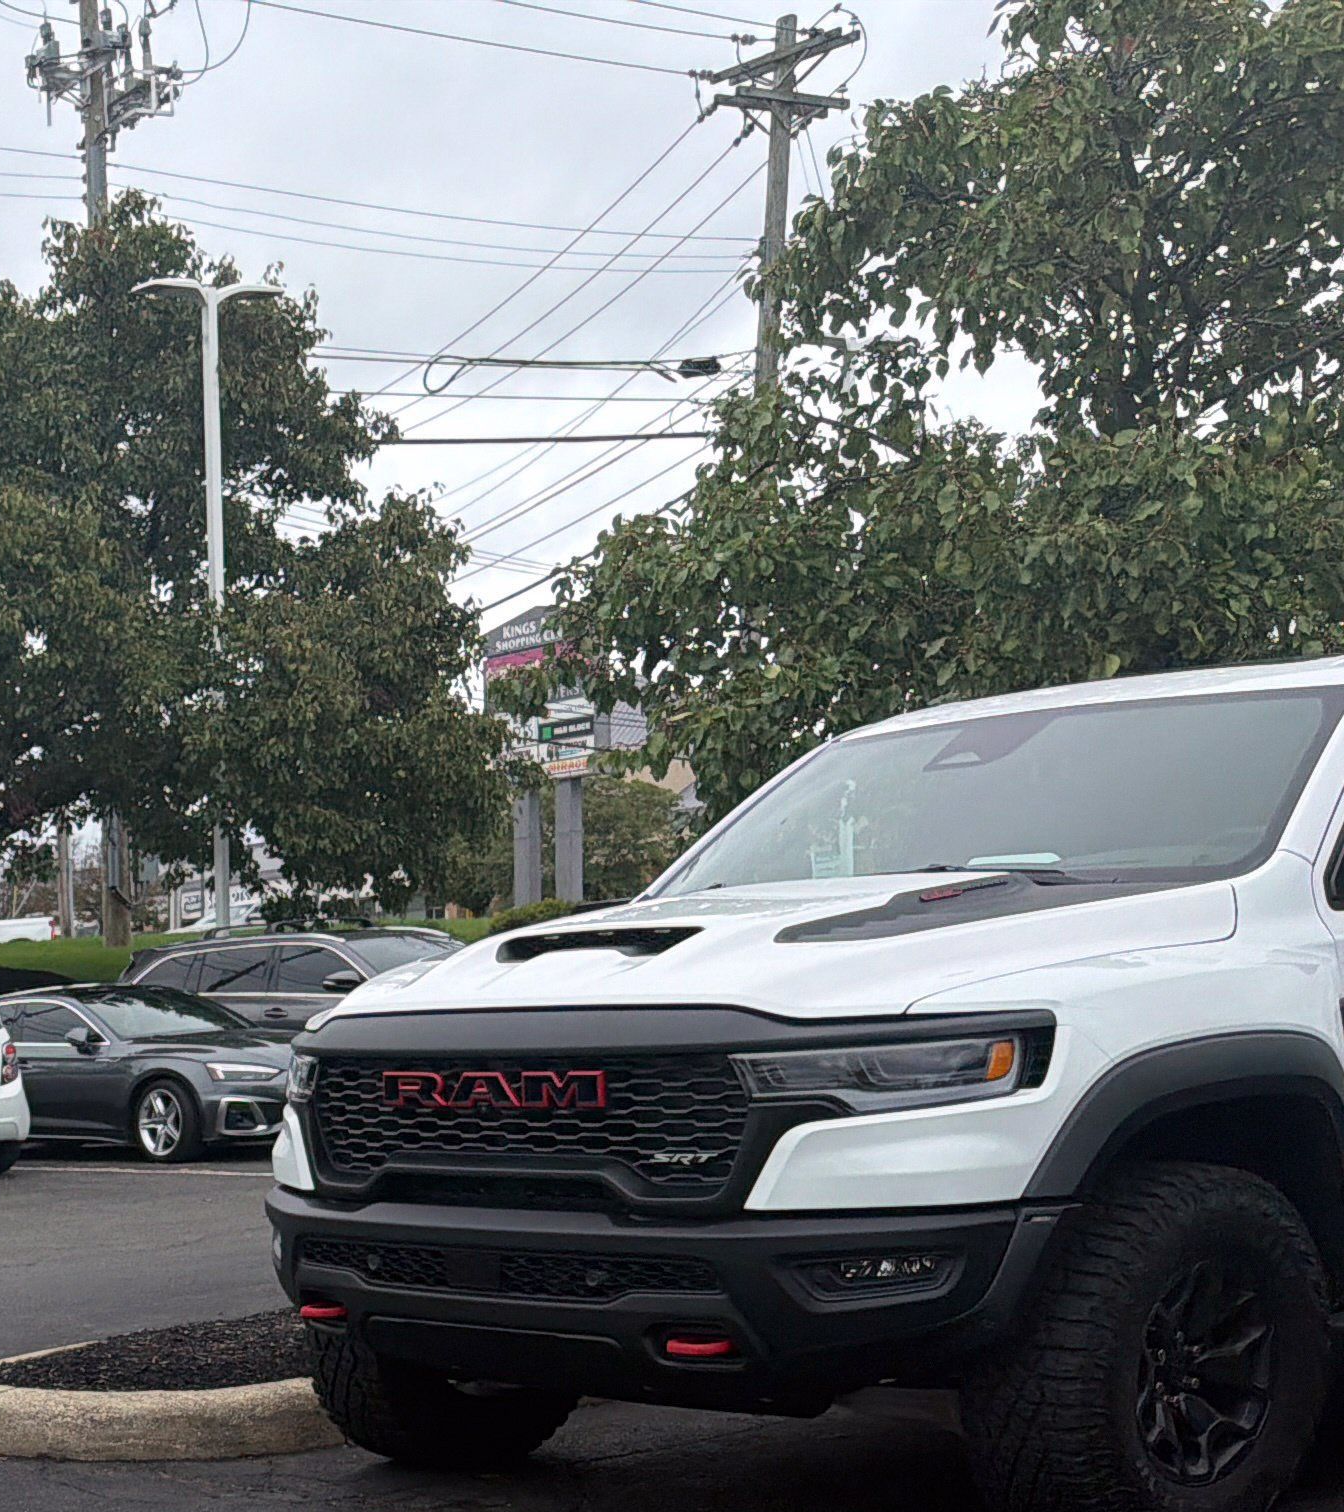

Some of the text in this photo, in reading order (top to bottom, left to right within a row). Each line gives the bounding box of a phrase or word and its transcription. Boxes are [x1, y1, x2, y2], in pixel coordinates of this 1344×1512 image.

[502, 621, 537, 639] KINGS
[495, 636, 542, 652] SHOPPING
[383, 1071, 606, 1108] RAM
[651, 1153, 718, 1166] SRT
